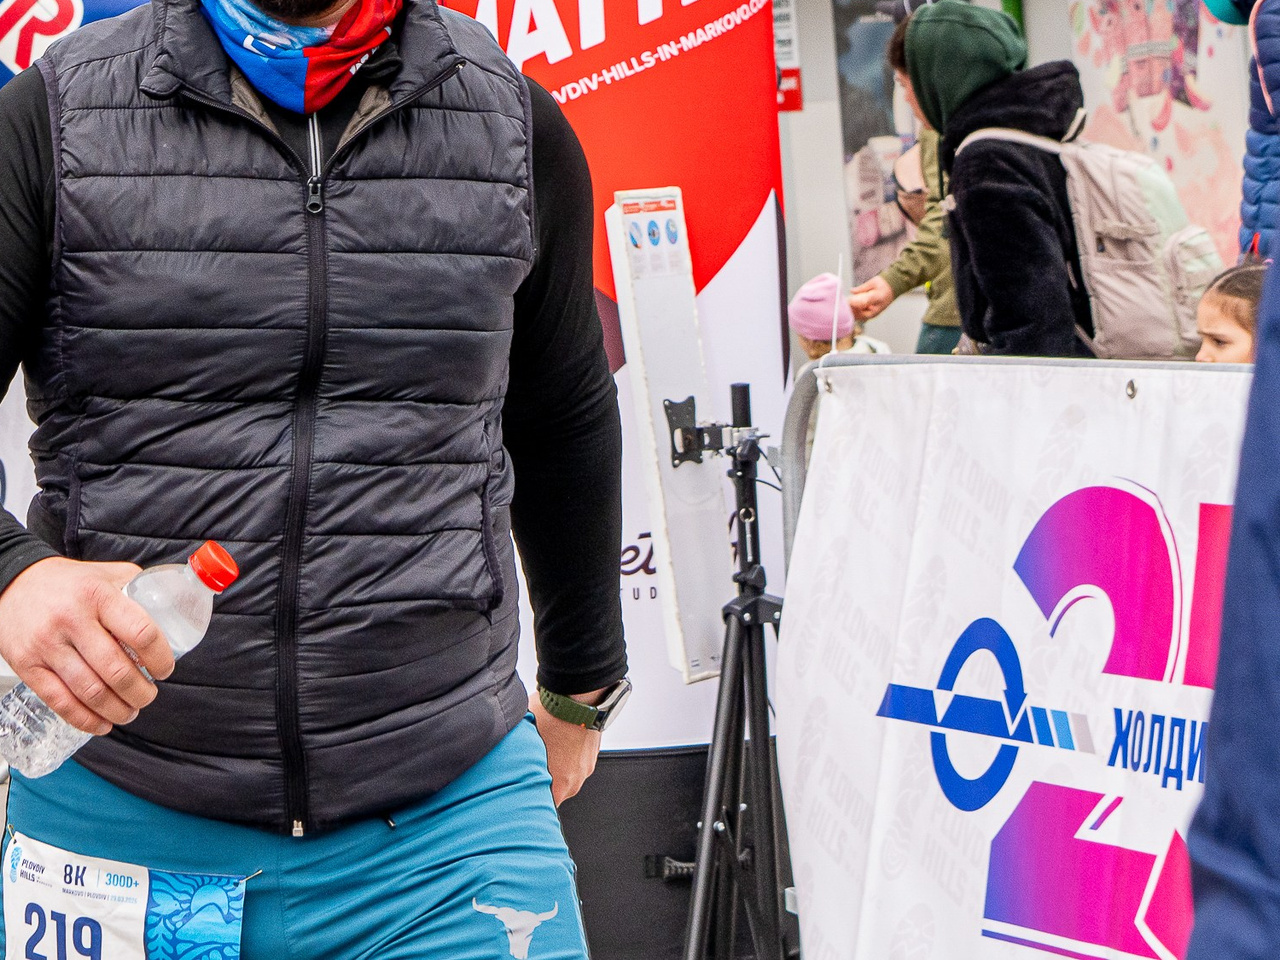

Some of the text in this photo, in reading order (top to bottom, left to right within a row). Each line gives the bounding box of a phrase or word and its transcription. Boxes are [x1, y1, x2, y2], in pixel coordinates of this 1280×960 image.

[19, 869, 36, 883] HILLS
[21, 858, 46, 875] PLOVDIV
[63, 863, 87, 887] 8K
[105, 873, 140, 889] 300D+
[24, 902, 102, 960] 219
